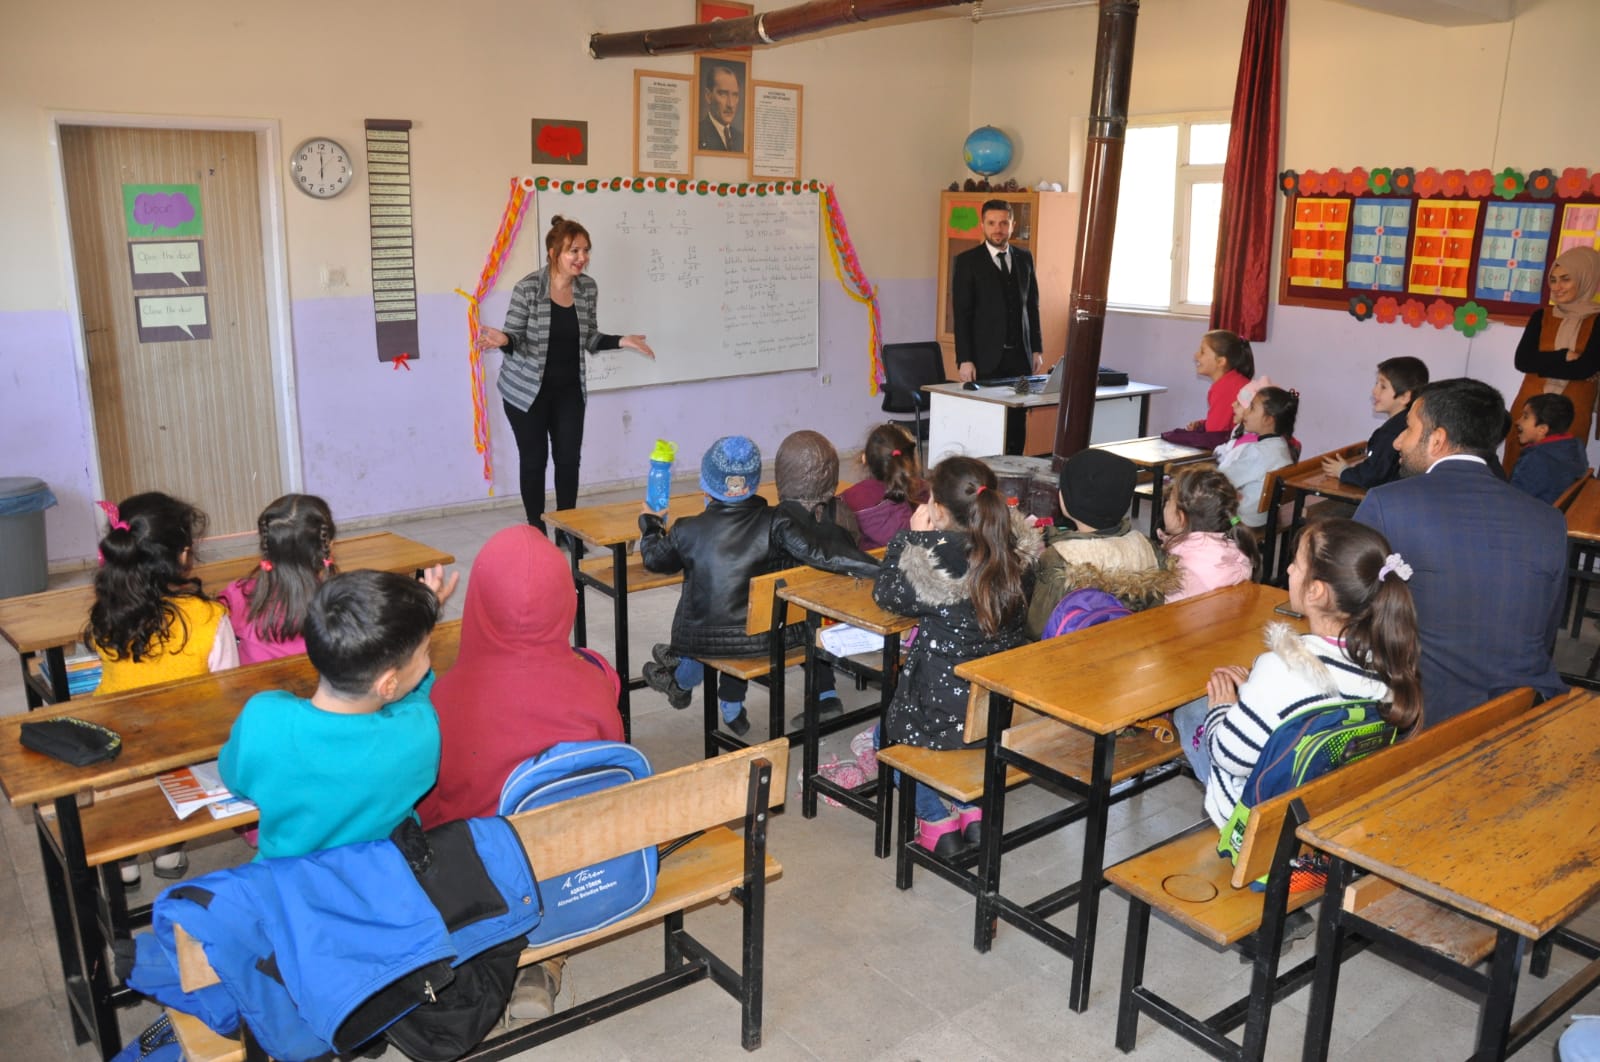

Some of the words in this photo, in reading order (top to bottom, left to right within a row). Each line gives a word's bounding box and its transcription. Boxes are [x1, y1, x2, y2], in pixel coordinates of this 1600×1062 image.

[337, 155, 343, 163] 2
[341, 165, 346, 174] 3
[300, 175, 307, 183] 8
[329, 183, 336, 191] 5
[162, 250, 175, 260] the
